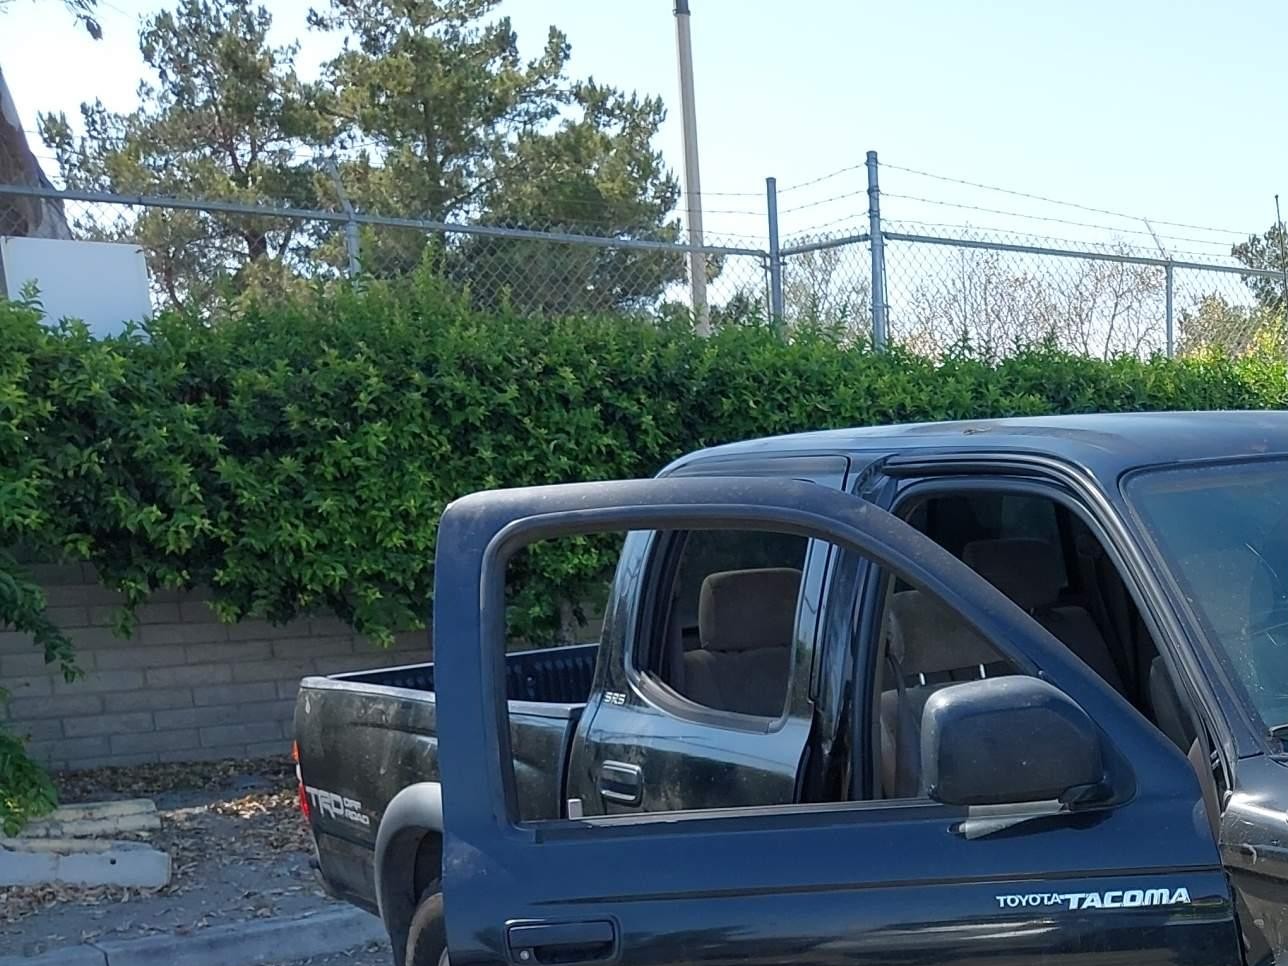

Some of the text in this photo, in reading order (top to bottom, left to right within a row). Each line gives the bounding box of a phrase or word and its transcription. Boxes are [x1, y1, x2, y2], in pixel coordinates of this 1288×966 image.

[305, 786, 345, 820] TRD
[344, 799, 362, 810] OFF
[345, 810, 371, 825] ROAD
[995, 887, 1192, 910] TOYOTA TACOMA
